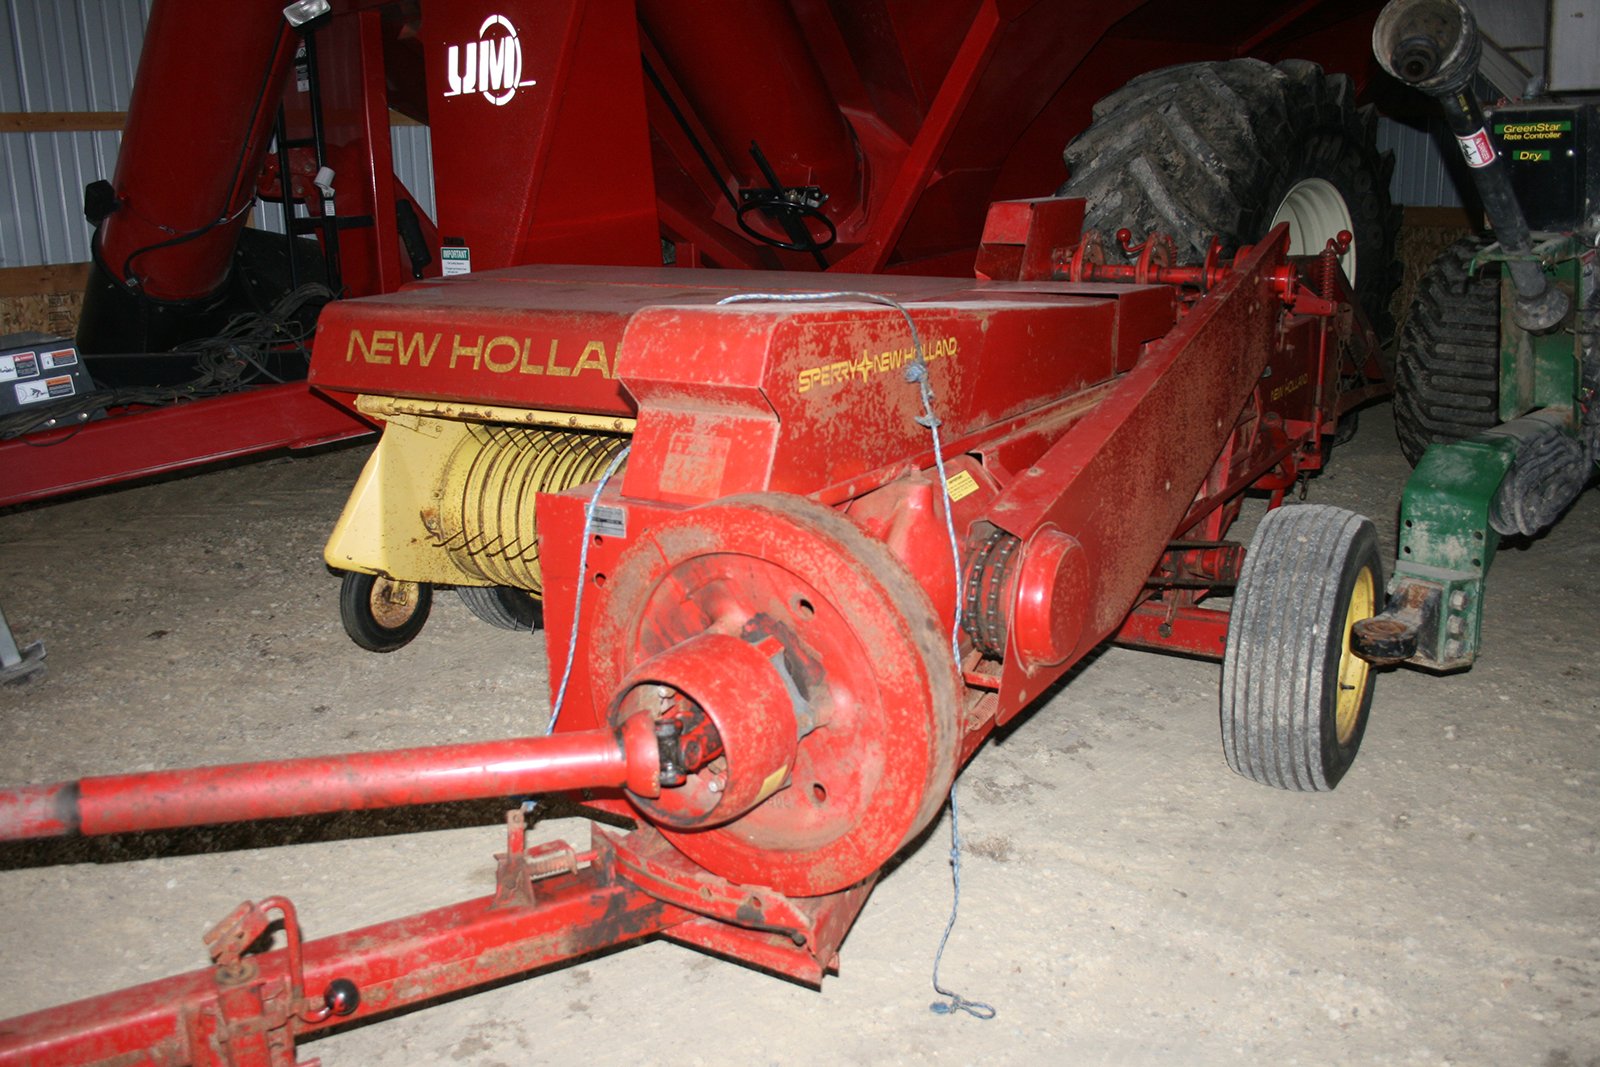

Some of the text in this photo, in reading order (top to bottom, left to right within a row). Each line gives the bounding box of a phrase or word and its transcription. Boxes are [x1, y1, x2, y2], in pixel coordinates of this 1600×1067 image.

[1503, 123, 1561, 133] GreenStar
[1523, 132, 1562, 140] Controller
[1520, 151, 1542, 162] Dry
[346, 329, 621, 379] NEW HOLLA
[798, 358, 858, 393] SPERRY
[873, 348, 902, 374] NEW
